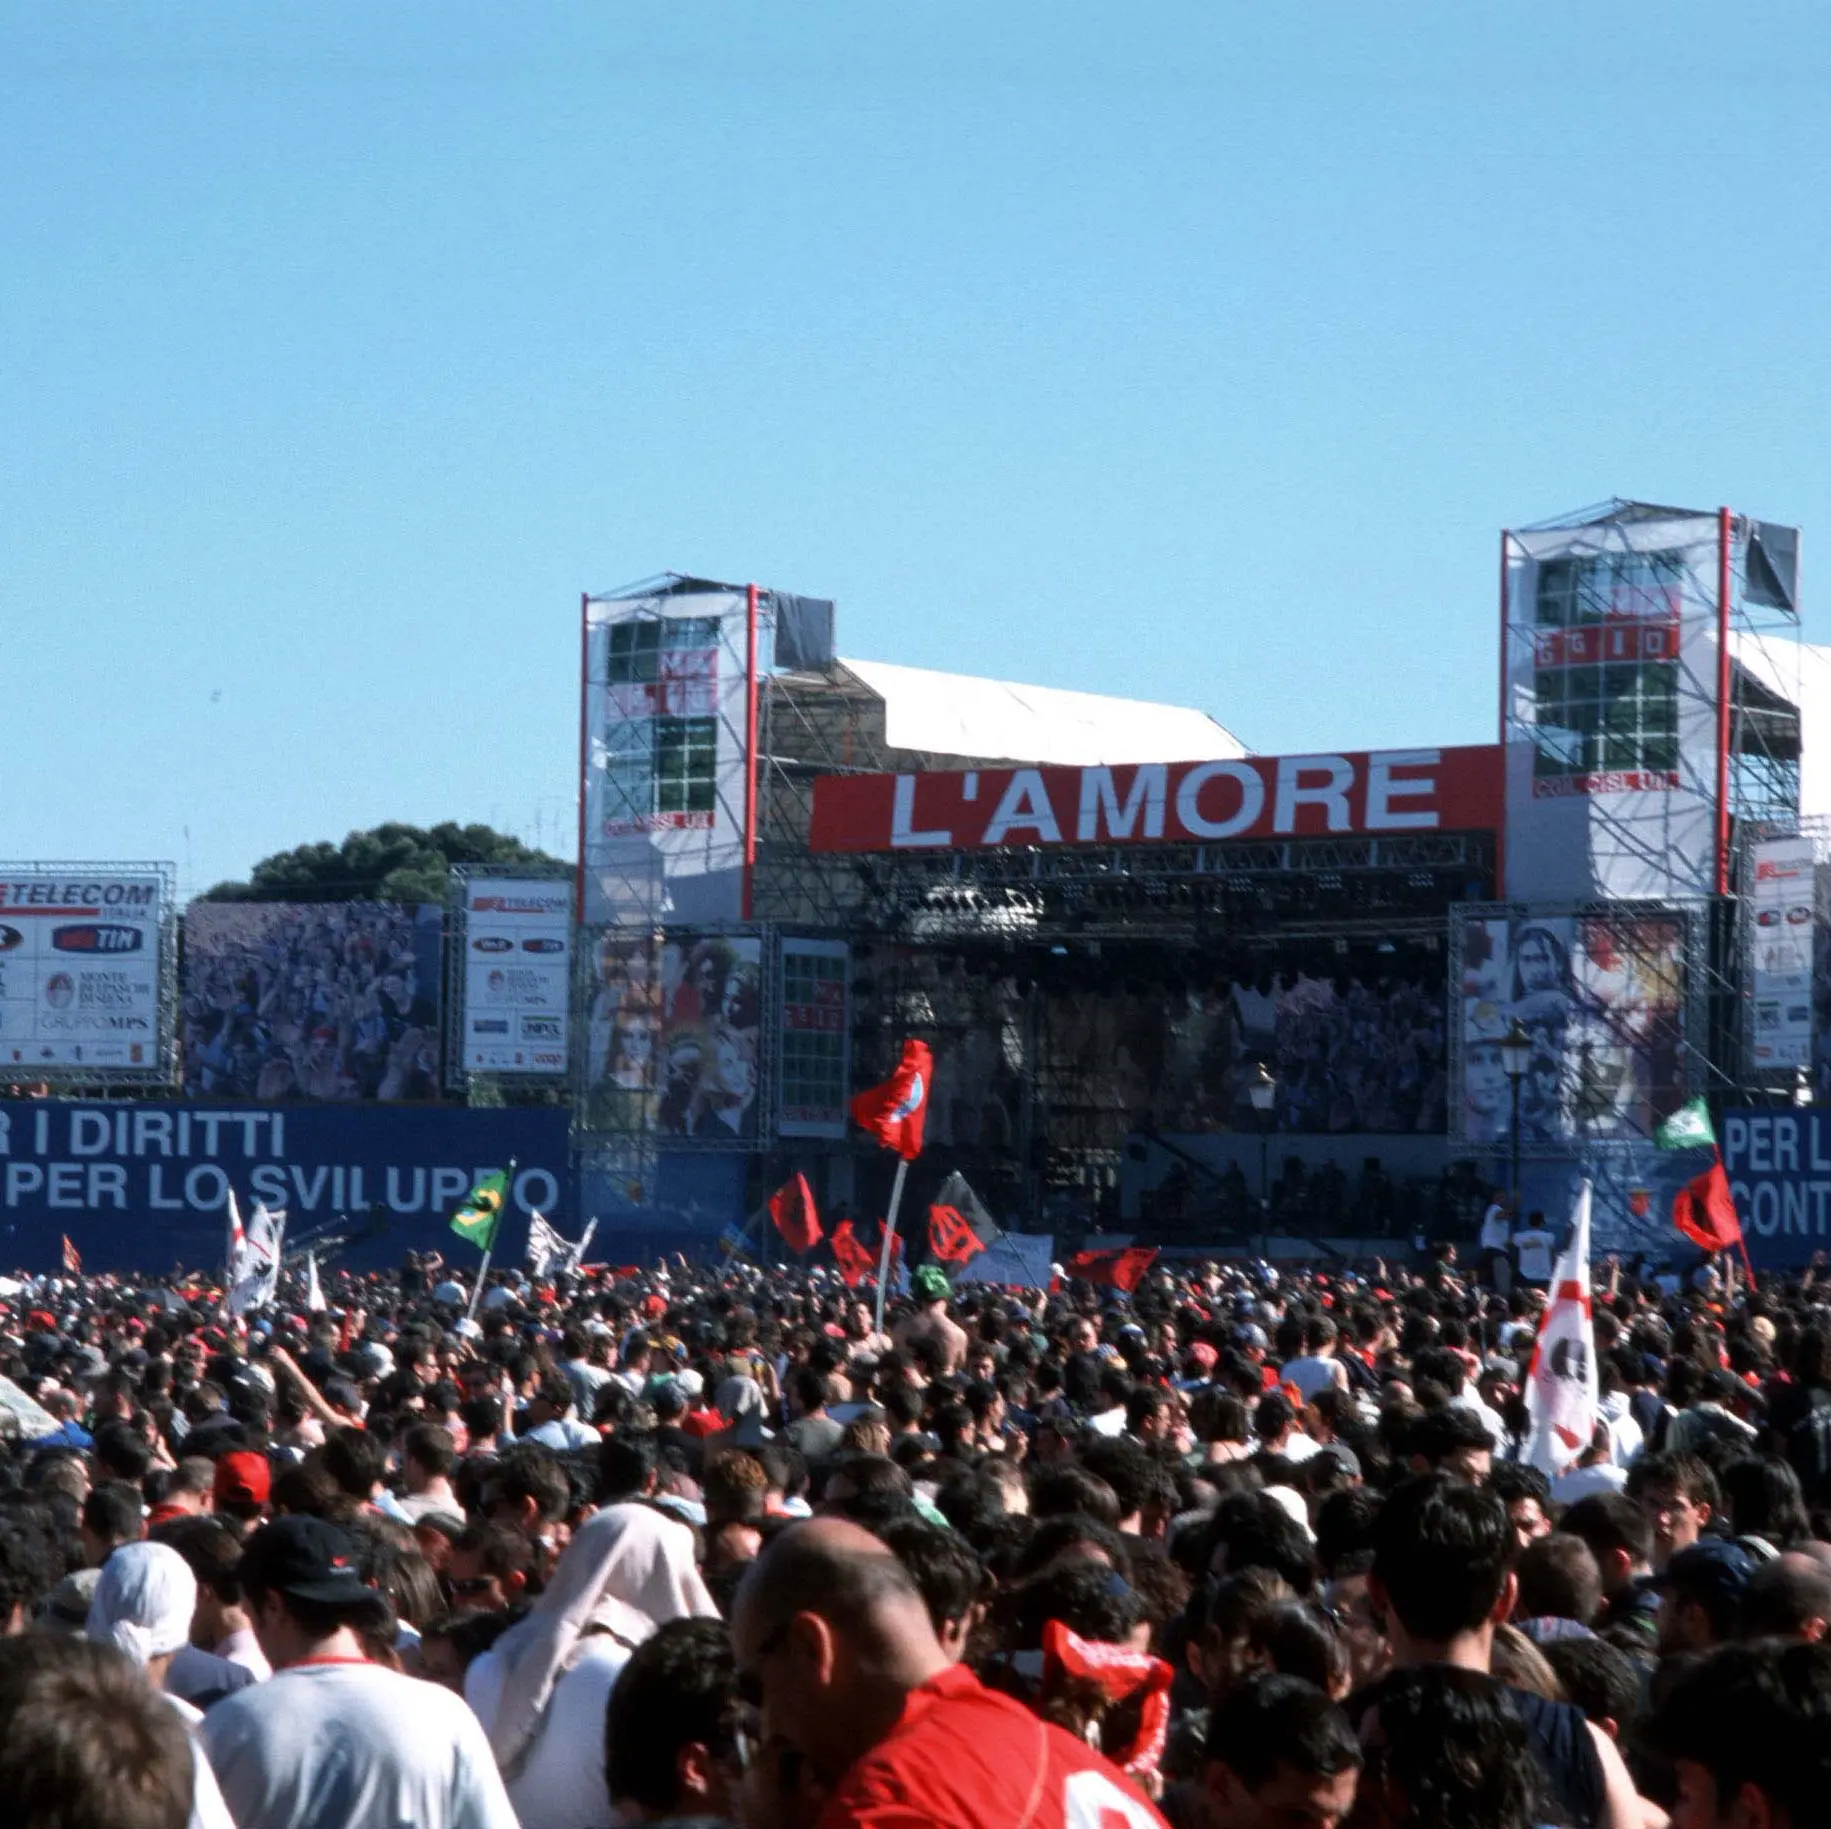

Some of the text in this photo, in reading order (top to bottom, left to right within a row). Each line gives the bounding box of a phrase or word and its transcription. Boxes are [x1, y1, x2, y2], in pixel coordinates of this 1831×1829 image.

[891, 748, 1441, 846] L'AMORE
[11, 883, 153, 904] TELECOM
[70, 1110, 284, 1157] DIRITTI
[1725, 1115, 1800, 1172] PER
[5, 1162, 128, 1210] PER
[149, 1163, 229, 1211] LO
